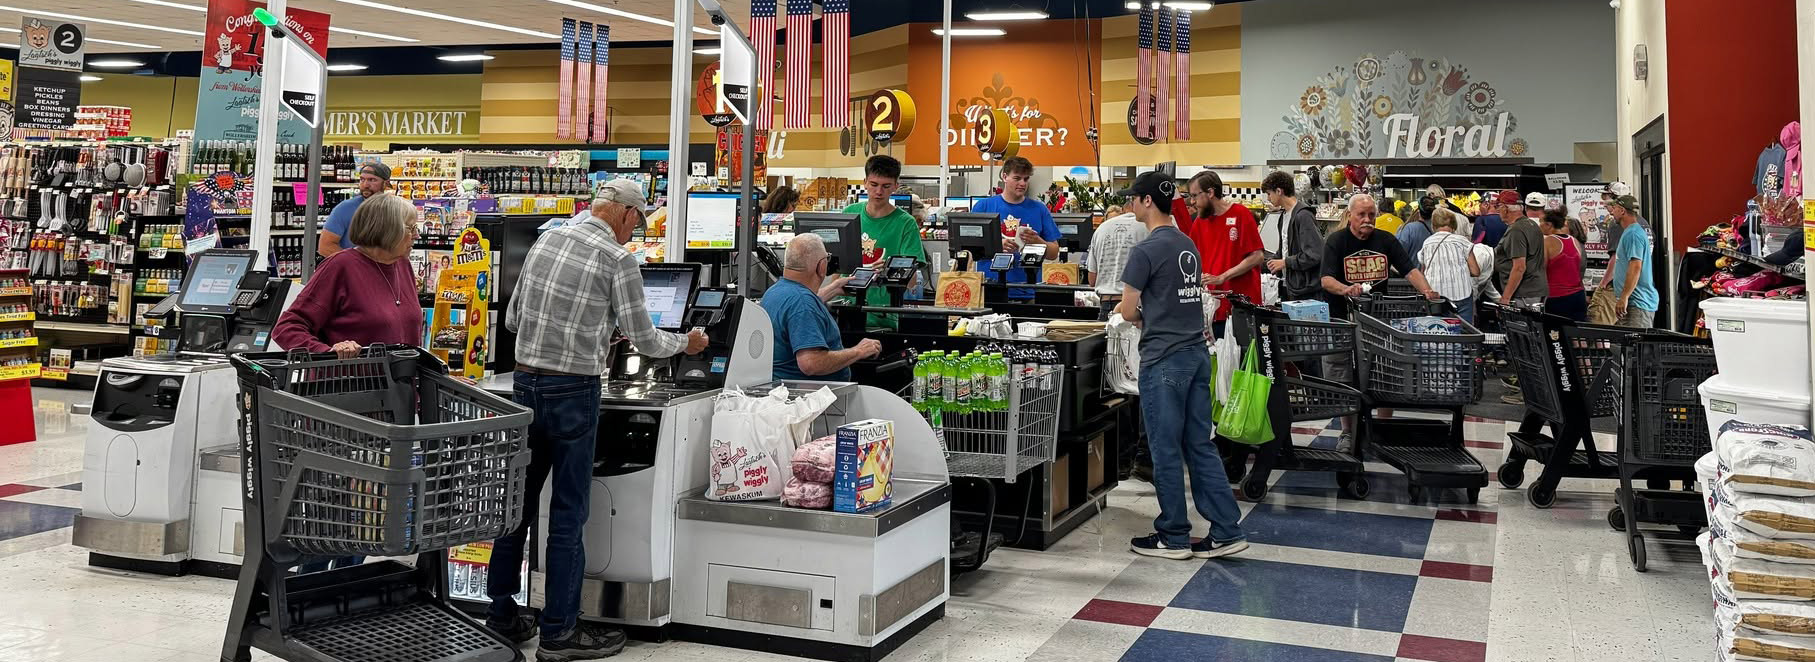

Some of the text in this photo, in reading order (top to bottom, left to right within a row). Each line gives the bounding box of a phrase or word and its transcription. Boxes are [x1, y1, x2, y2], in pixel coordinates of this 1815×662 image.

[60, 31, 75, 47] 2
[303, 31, 315, 45] on
[63, 59, 81, 67] wiggly
[241, 105, 295, 121] pigg ggly
[872, 95, 893, 131] 2
[1020, 105, 1041, 122] for
[323, 111, 467, 136] MER'S MARKET
[978, 114, 992, 144] 3
[1382, 112, 1510, 158] Floral
[767, 130, 787, 159] li
[1346, 256, 1386, 274] SCAG
[1262, 335, 1272, 360] piggly
[1552, 341, 1571, 392] piggly wiggly
[860, 424, 888, 441] FRANZIA
[245, 413, 254, 499] piggly wiggly
[744, 465, 768, 478] piggly
[743, 475, 769, 487] wiggly
[719, 490, 763, 500] KEWASKUM
